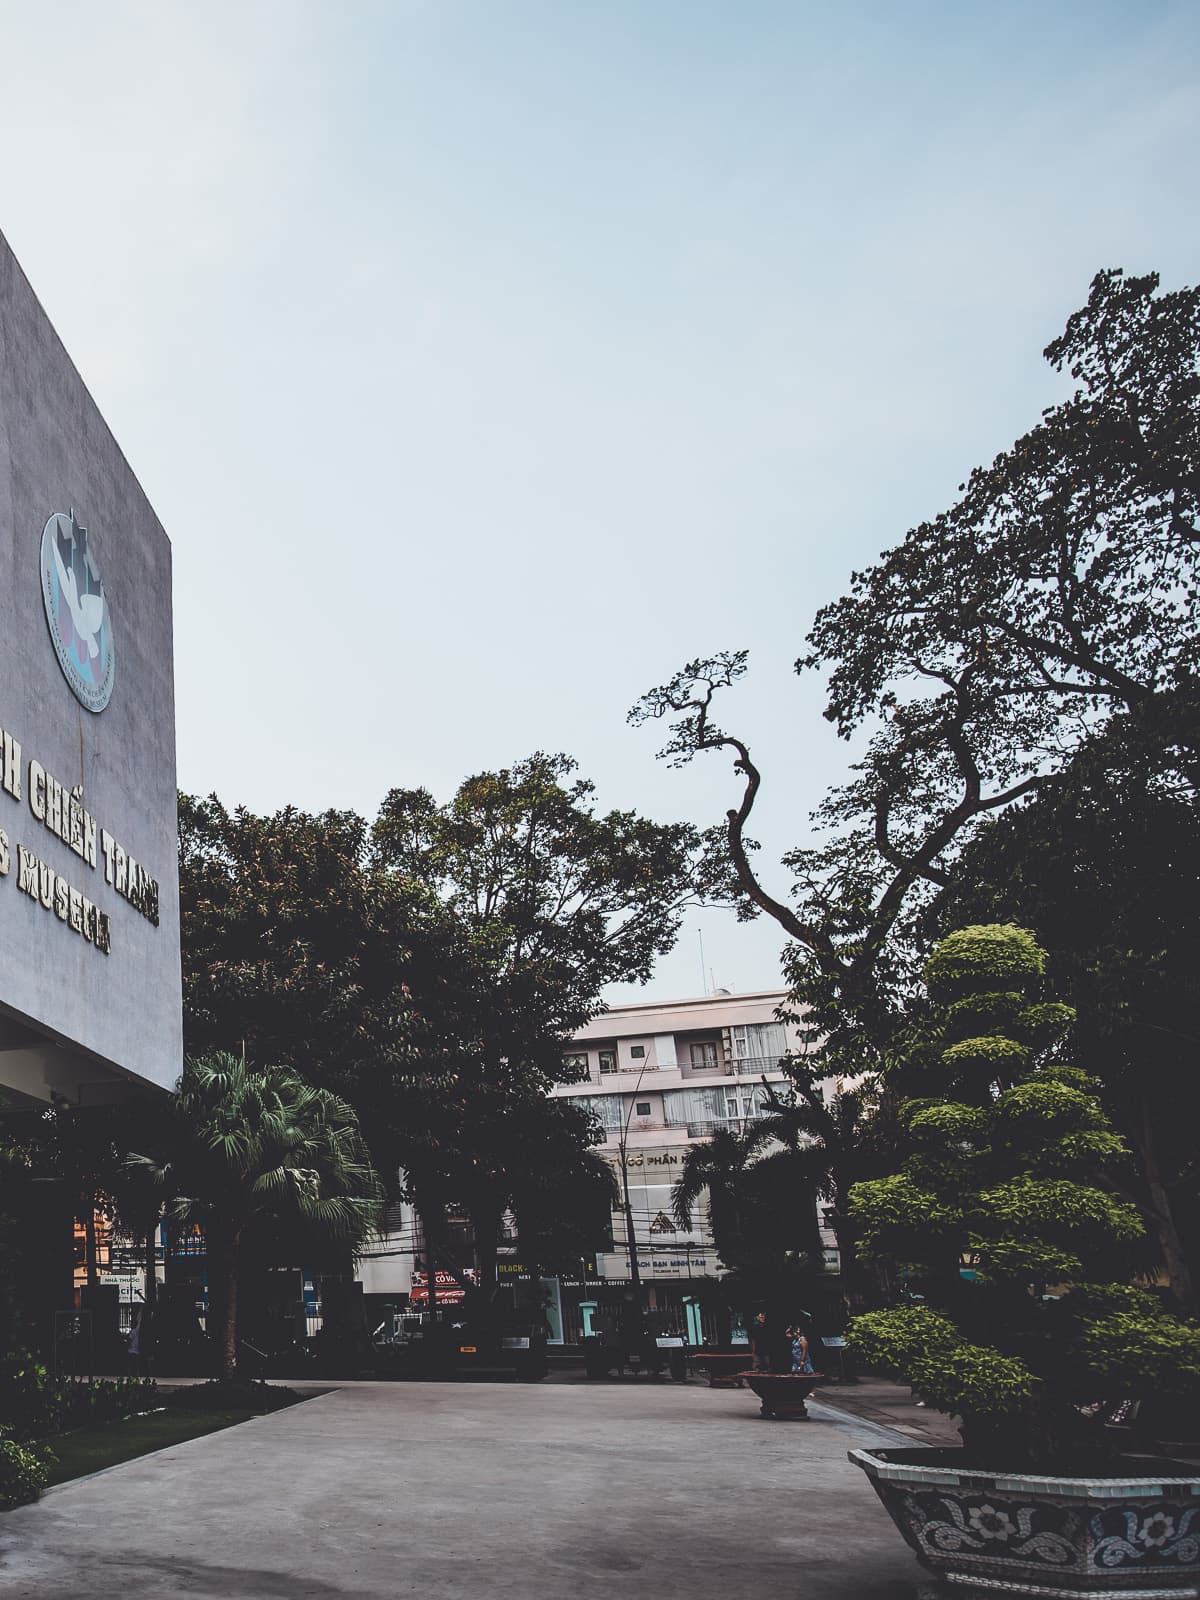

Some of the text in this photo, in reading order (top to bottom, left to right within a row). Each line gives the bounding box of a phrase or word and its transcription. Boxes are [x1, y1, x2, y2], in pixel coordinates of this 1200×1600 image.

[28, 759, 96, 868] CHIẾN
[17, 844, 111, 954] MUSEUM
[499, 1264, 523, 1273] BLACK
